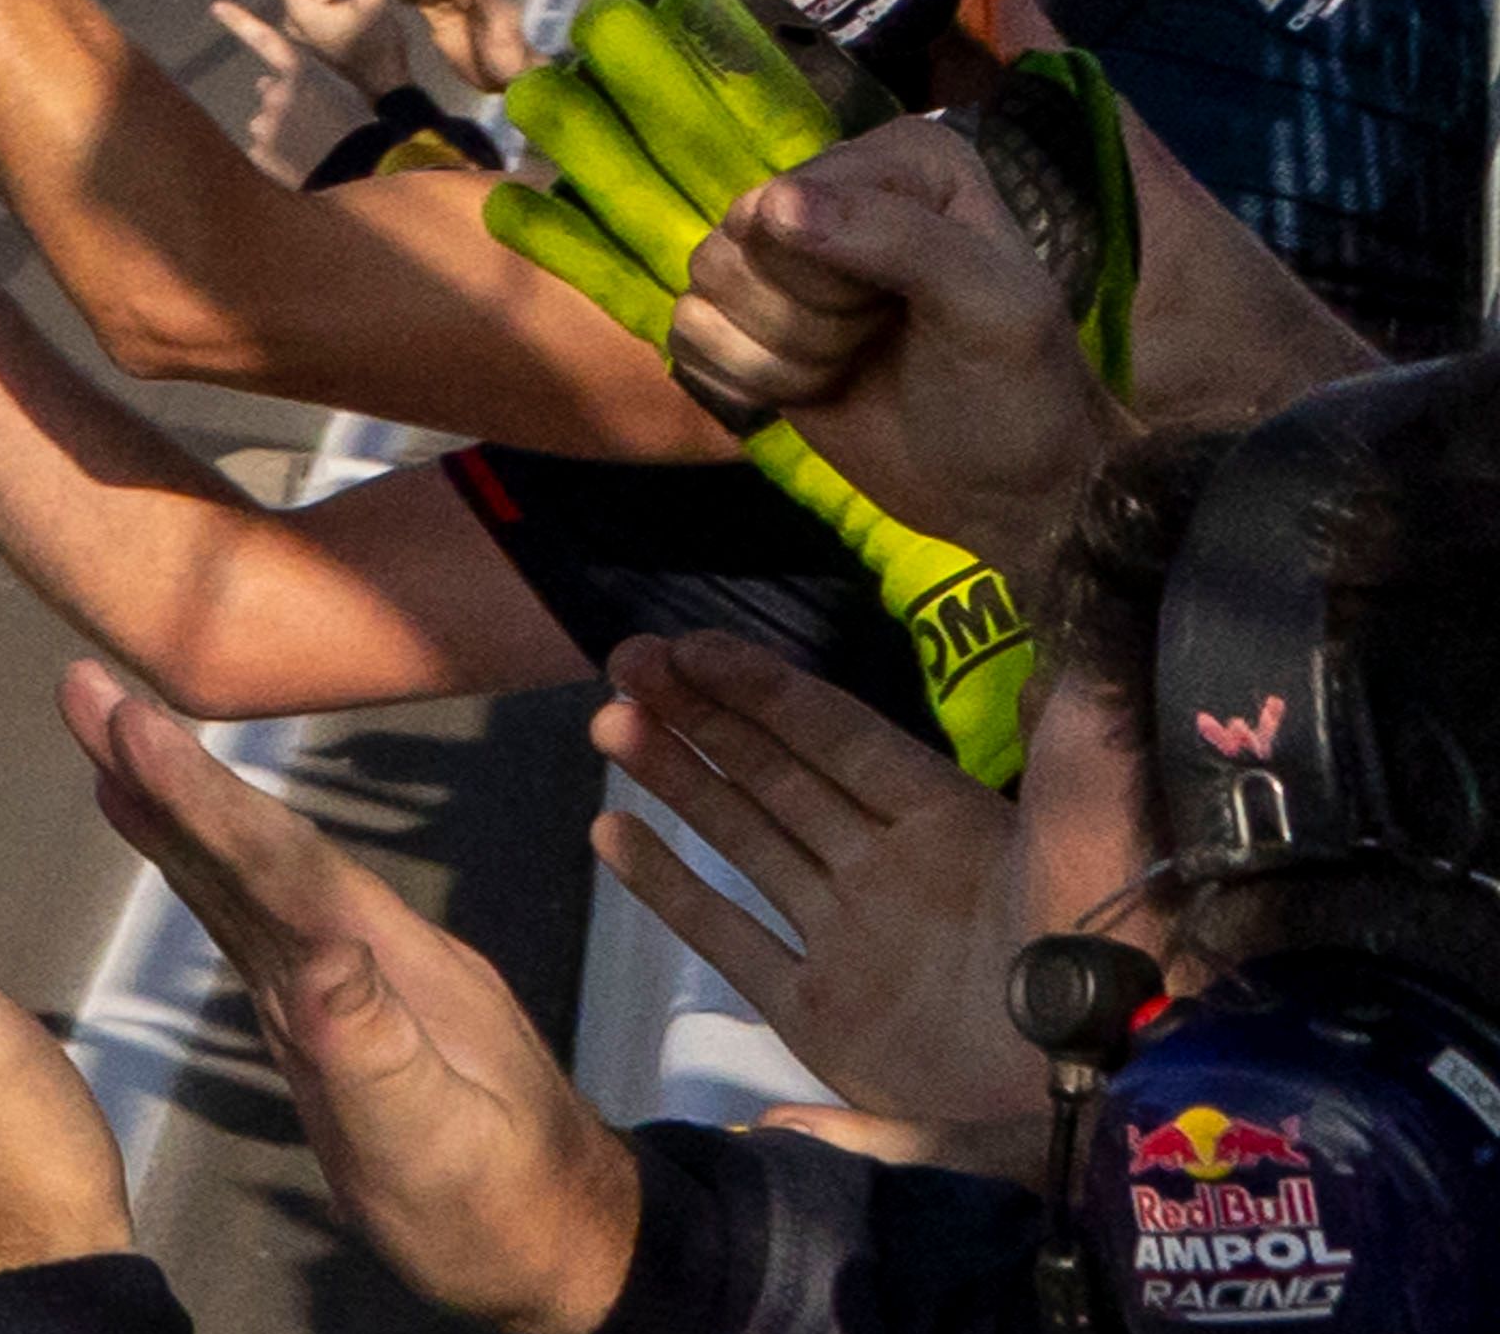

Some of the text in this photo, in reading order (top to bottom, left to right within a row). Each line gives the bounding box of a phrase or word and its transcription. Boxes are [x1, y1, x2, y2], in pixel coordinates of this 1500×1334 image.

[1131, 1178, 1320, 1233] Red Bull
[1134, 1231, 1353, 1272] AMPOL
[1143, 1272, 1346, 1313] RACING
